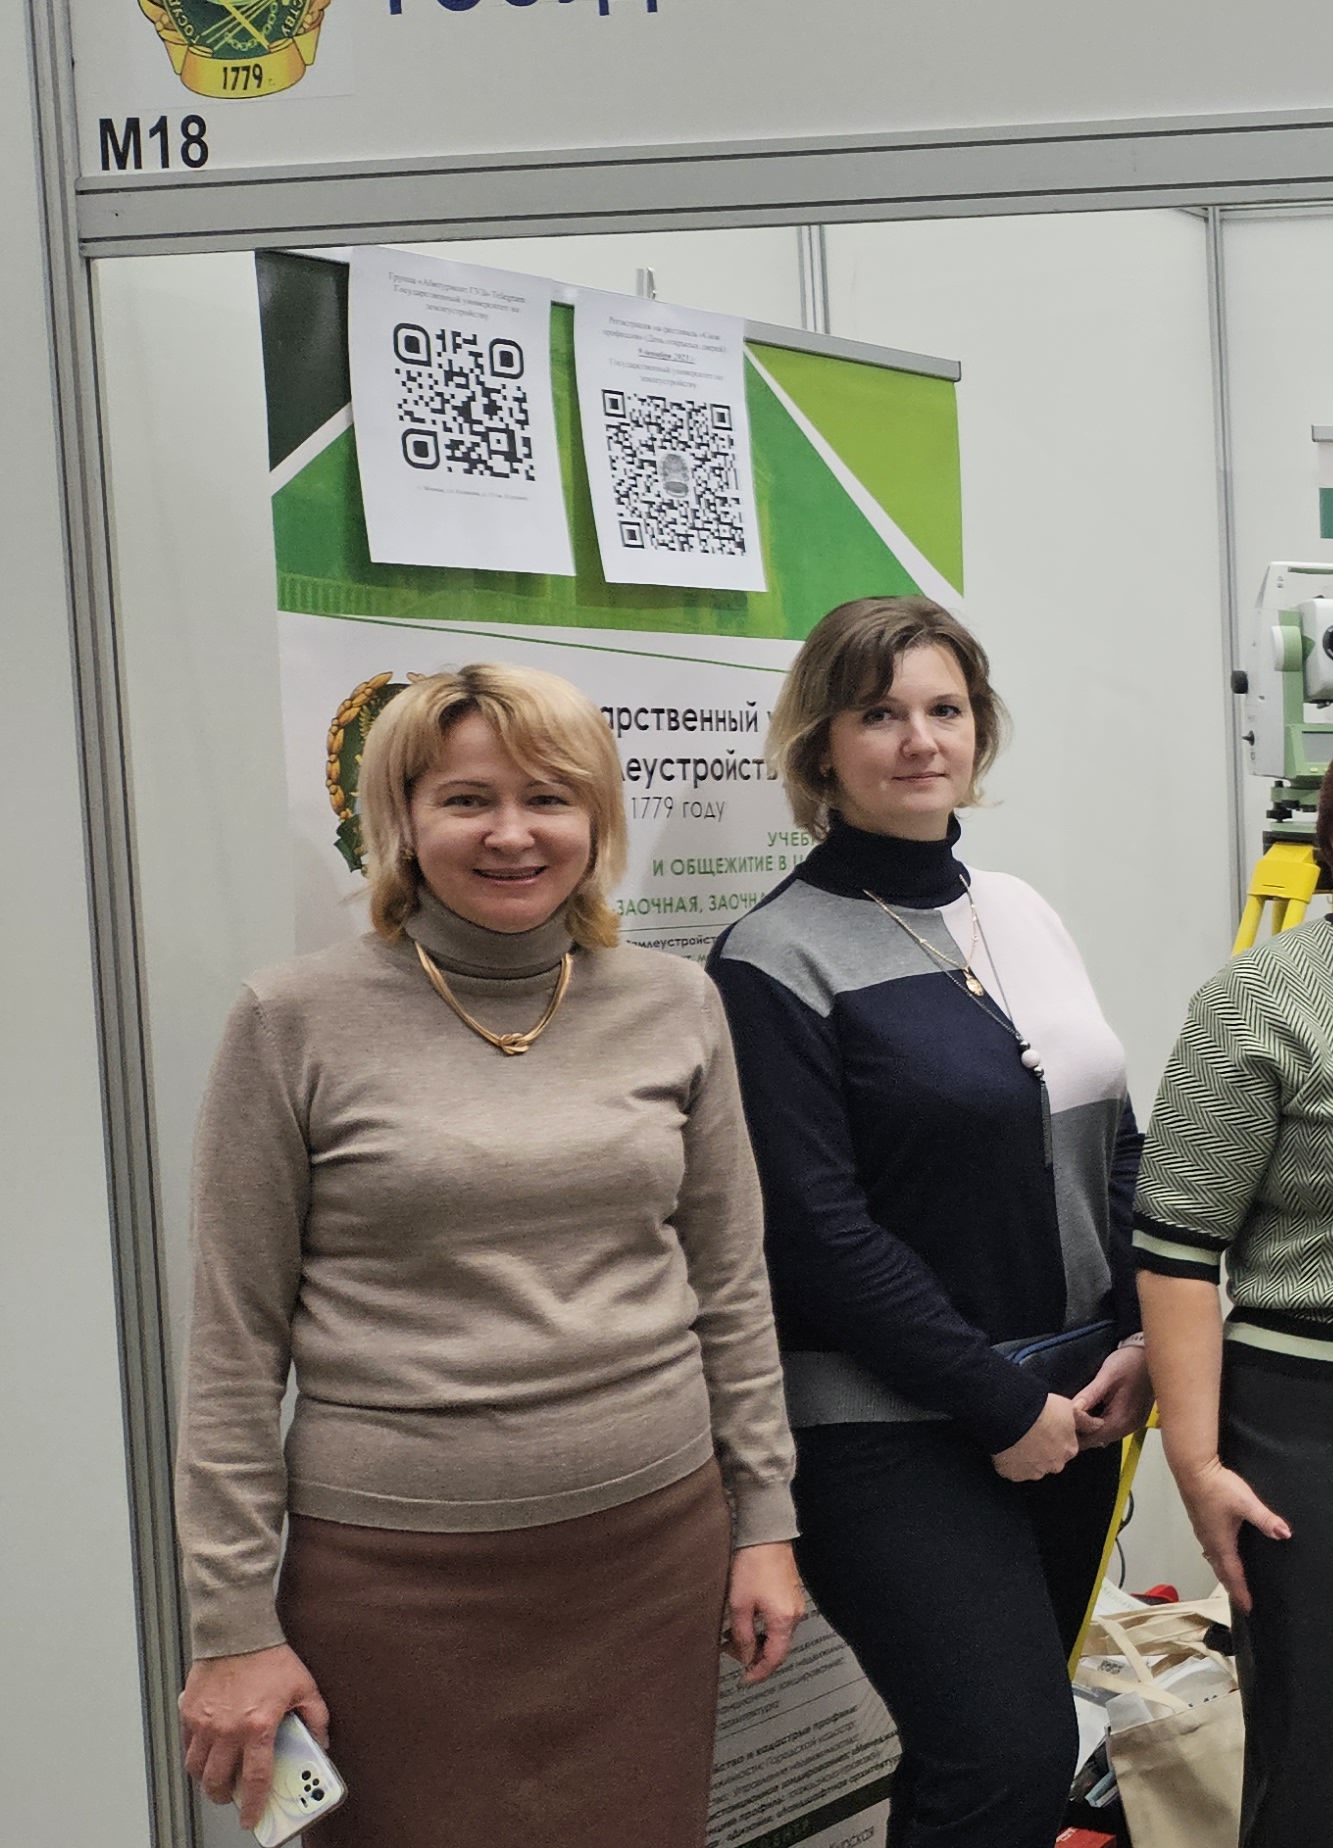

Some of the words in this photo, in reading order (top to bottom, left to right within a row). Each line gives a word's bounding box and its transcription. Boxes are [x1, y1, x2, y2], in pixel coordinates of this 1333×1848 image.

[222, 63, 264, 91] 1779
[99, 115, 210, 171] M18
[631, 796, 674, 819] 1779
[683, 800, 726, 822] году
[652, 860, 664, 877] И
[670, 855, 773, 877] ОБЩЕЖИТИЕ
[778, 856, 788, 871] В
